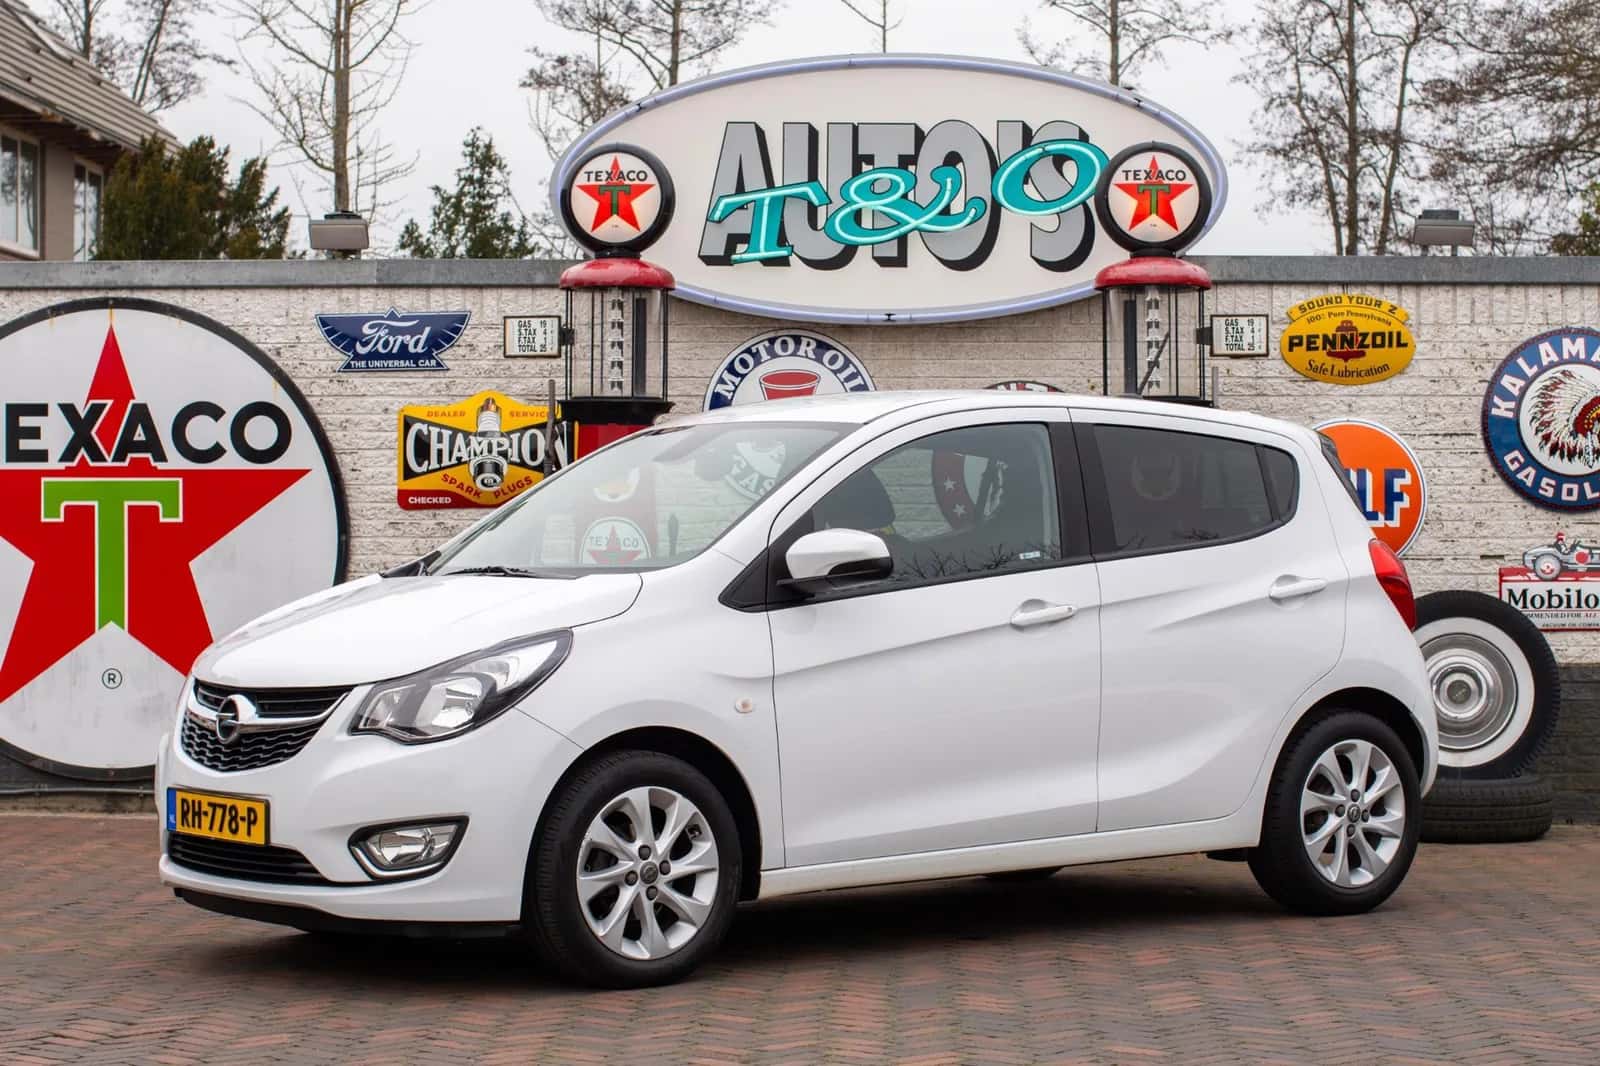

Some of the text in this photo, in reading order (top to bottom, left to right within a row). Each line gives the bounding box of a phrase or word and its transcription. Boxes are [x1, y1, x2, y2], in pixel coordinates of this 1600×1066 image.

[584, 170, 648, 182] TEXACO
[1122, 169, 1187, 182] TEXACO
[1298, 295, 1398, 315] SOUND YOUR Z
[518, 320, 531, 328] GAS
[1225, 318, 1239, 326] GAS
[355, 319, 432, 355] Ford
[1225, 343, 1245, 351] TOTAL
[1288, 330, 1409, 353] PENNZOIL
[518, 344, 537, 352] TOTAL
[368, 360, 417, 368] UNIVERSAL
[715, 336, 817, 400] MOTOR
[1305, 358, 1390, 378] Safe Lubrication
[406, 421, 568, 474] CHAMPION
[441, 472, 533, 499] SPARK PLUGS
[408, 496, 452, 504] CHECKED
[1344, 468, 1412, 527] LF
[180, 797, 258, 837] RH-778-P
